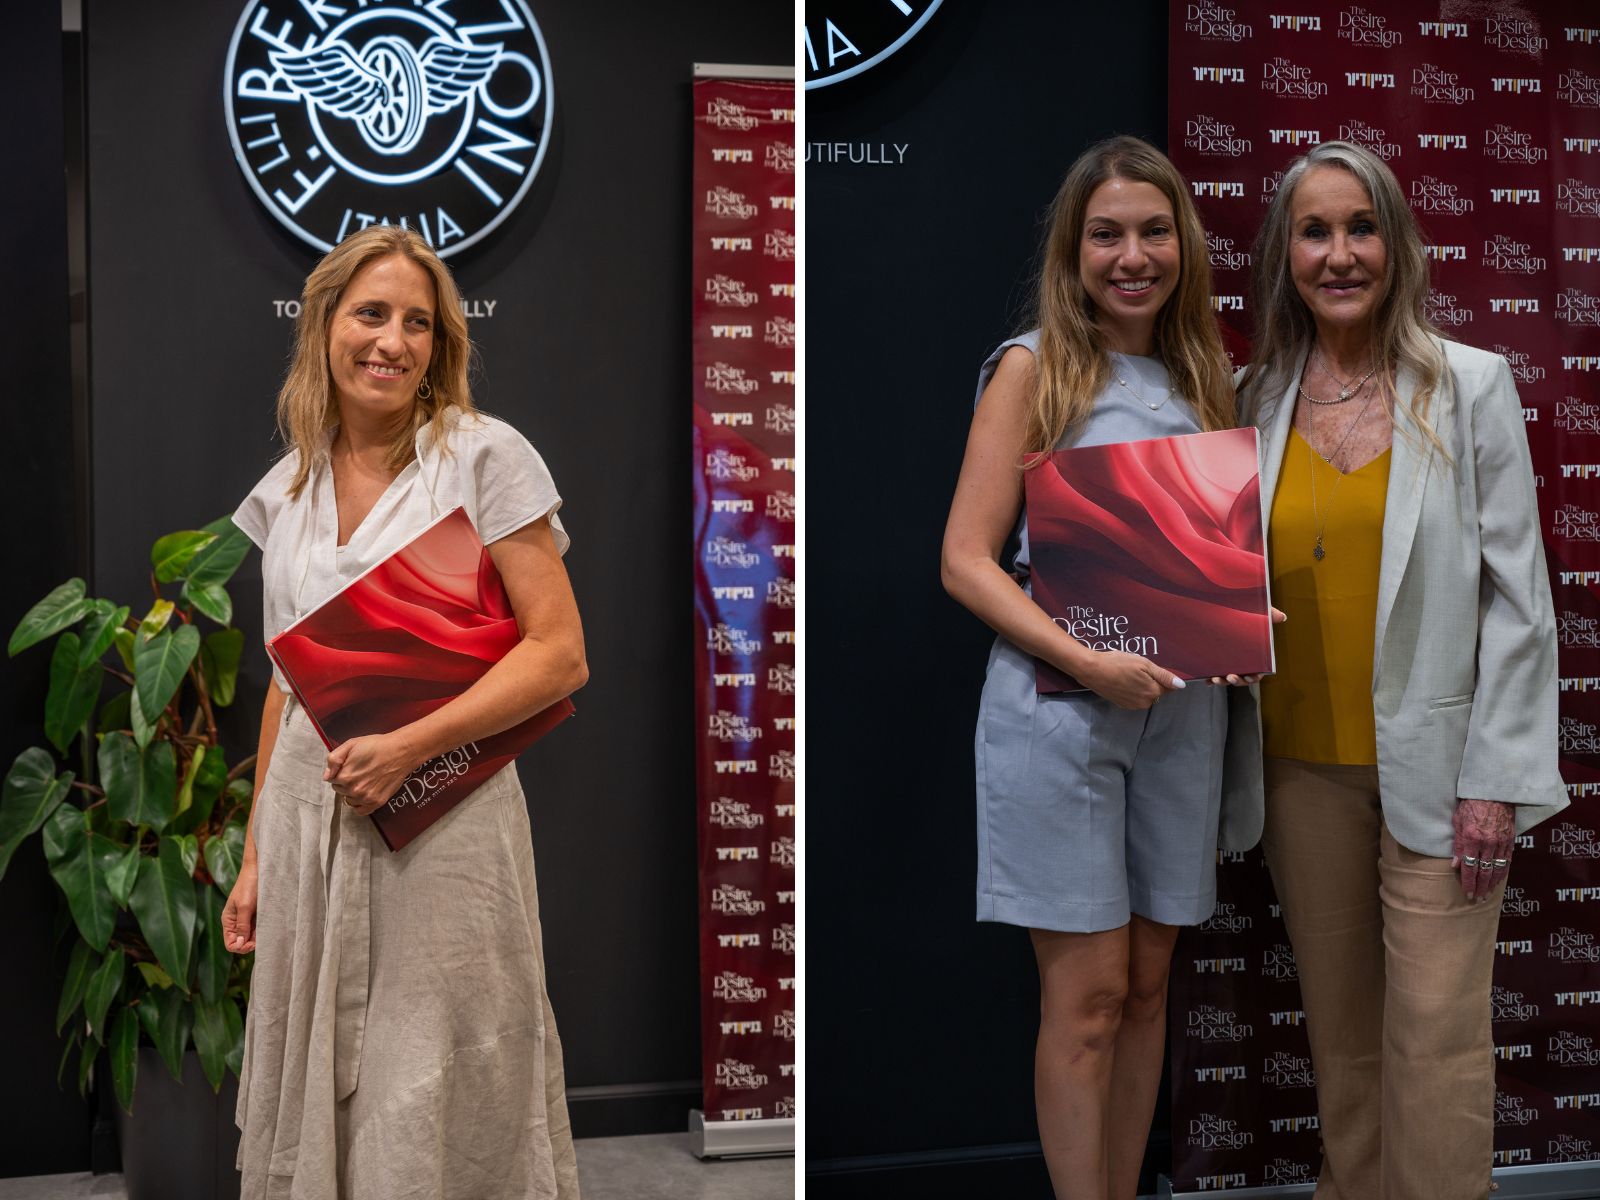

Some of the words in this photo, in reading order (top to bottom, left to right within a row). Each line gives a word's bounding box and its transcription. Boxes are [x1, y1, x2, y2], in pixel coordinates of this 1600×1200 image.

[1197, 0, 1215, 8] The
[1349, 5, 1366, 15] The
[1187, 4, 1236, 22] Desire
[1340, 11, 1386, 29] Desire
[1185, 22, 1199, 32] For
[1199, 20, 1253, 42] Design
[1486, 18, 1532, 35] Desire
[1337, 29, 1351, 38] For
[1351, 27, 1402, 49] Design
[1497, 33, 1548, 54] Design
[1273, 57, 1290, 66] The
[1422, 63, 1438, 72] The
[1263, 63, 1311, 80] Desire
[1412, 69, 1458, 85] Desire
[1261, 81, 1275, 90] For
[1275, 78, 1328, 100] Design
[1558, 74, 1600, 90] Desire
[1410, 86, 1424, 95] For
[1424, 84, 1474, 105] Design
[1196, 114, 1214, 124] The
[1186, 120, 1235, 137] Desire
[1339, 125, 1385, 143] Desire
[1494, 124, 1511, 133] The
[1485, 129, 1531, 146] Desire
[1184, 138, 1199, 147] For
[1198, 136, 1252, 157] Design
[1483, 147, 1497, 156] For
[1497, 144, 1547, 165] Design
[1421, 175, 1438, 184] The
[1412, 181, 1457, 197] Desire
[1558, 184, 1600, 200] Desire
[1410, 198, 1423, 207] For
[1423, 196, 1473, 216] Design
[1494, 234, 1511, 244] The
[1484, 240, 1530, 256] Desire
[1210, 251, 1251, 270] esign
[1482, 257, 1496, 266] For
[1496, 255, 1546, 275] Design
[272, 300, 301, 318] TO
[1423, 293, 1457, 308] esire
[1557, 293, 1600, 309] Desire
[1511, 365, 1546, 384] esign
[1556, 402, 1599, 417] Desire
[1555, 510, 1598, 524] Desire
[1067, 605, 1094, 619] The
[387, 791, 409, 813] For
[403, 742, 480, 804] Design
[1551, 828, 1595, 843] Desire
[1562, 841, 1600, 859] Desig
[1502, 899, 1540, 916] esign
[1550, 932, 1594, 947] Desire
[1561, 945, 1600, 963] Desig
[1188, 1010, 1236, 1026] Desire
[1200, 1023, 1253, 1042] Design
[1549, 1036, 1592, 1051] Desire
[1264, 1057, 1311, 1073] Desire
[1560, 1048, 1600, 1066] Desig
[1276, 1071, 1317, 1088] Desig
[1190, 1118, 1236, 1135] Desire
[1201, 1131, 1253, 1150] Design
[1548, 1139, 1592, 1154] Desire
[1264, 1164, 1311, 1180] Desire
